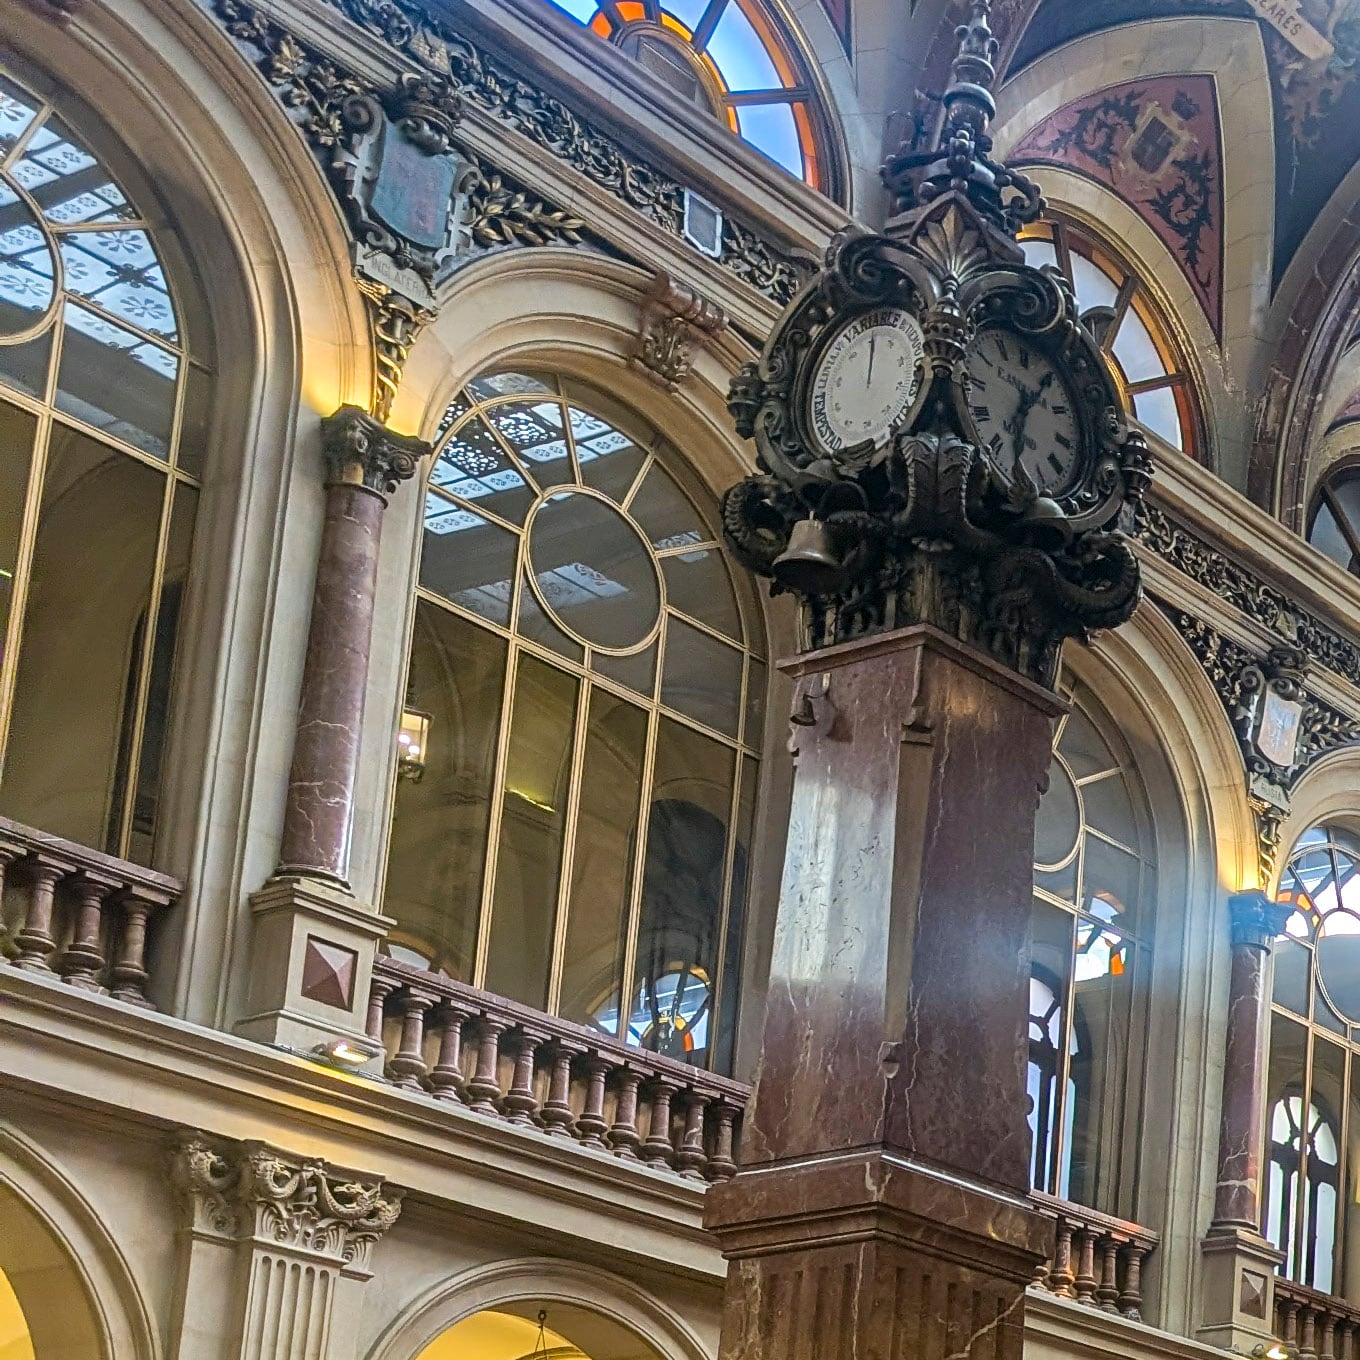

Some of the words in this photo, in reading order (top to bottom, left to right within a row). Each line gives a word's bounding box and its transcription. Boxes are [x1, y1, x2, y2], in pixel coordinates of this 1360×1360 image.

[1254, 0, 1301, 36] EARES
[843, 312, 902, 343] VARIABLE
[814, 392, 843, 450] TEMPESTAD
